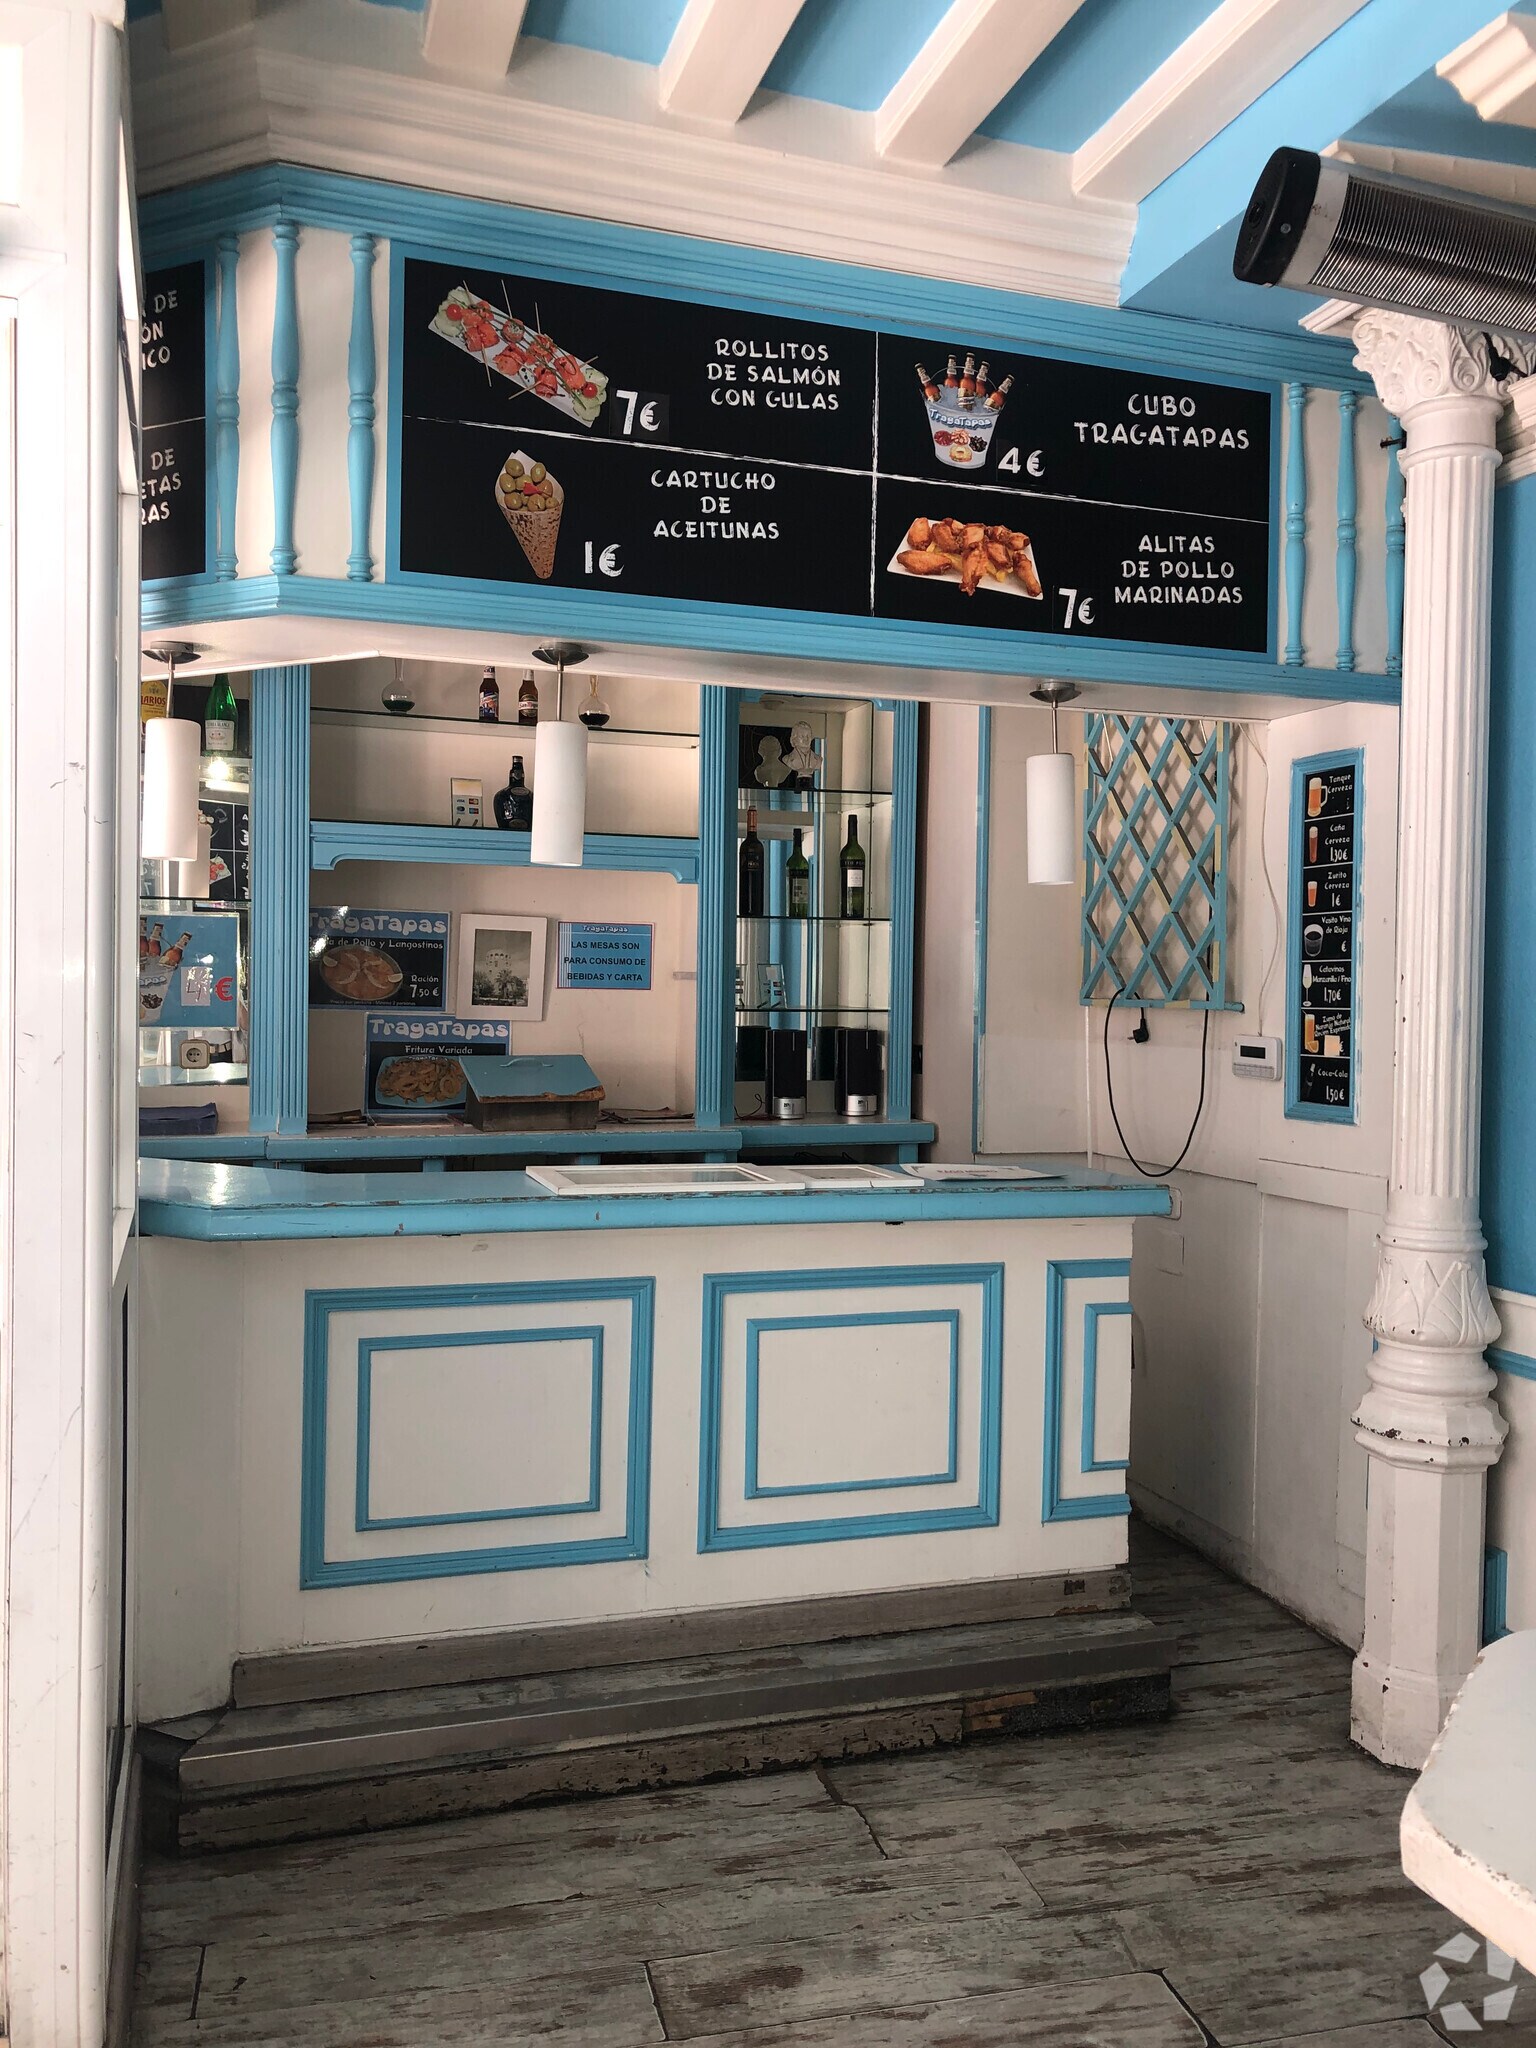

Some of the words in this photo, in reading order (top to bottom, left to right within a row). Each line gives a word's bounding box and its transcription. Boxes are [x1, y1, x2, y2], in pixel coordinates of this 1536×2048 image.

[154, 290, 178, 313] DE
[715, 339, 828, 361] ROLLITOS
[707, 363, 736, 380] DE
[748, 366, 840, 385] SALMÓN
[711, 388, 755, 406] CON
[766, 391, 838, 410] GULAS
[1128, 394, 1195, 417] CUBO
[616, 390, 659, 434] 7€
[1074, 422, 1249, 449] TRAGATAPAS
[150, 448, 175, 471] DE
[998, 447, 1044, 476] 4€
[651, 470, 775, 490] CARTUCHO
[701, 496, 730, 513] DE
[654, 520, 779, 539] ACEITUNAS
[1139, 535, 1214, 553] ALITAS
[1122, 561, 1150, 578] DE
[1160, 561, 1234, 578] POLLO
[1115, 586, 1242, 603] MARINADAS
[1059, 588, 1094, 628] 7€
[1329, 774, 1351, 784] Tanque
[1328, 784, 1352, 794] Cerveza
[1330, 824, 1346, 832] Caña
[1324, 837, 1350, 845] Cerveza
[310, 912, 446, 936] TragaTapas
[338, 938, 349, 946] de
[353, 938, 376, 947] Pollo
[388, 941, 443, 950] Langostinos
[412, 975, 438, 983] Ración
[370, 1019, 508, 1040] TragaTapas
[405, 1045, 434, 1054] Fritura
[438, 1046, 472, 1054] Variada
[1318, 1068, 1348, 1077] Coca-Cola
